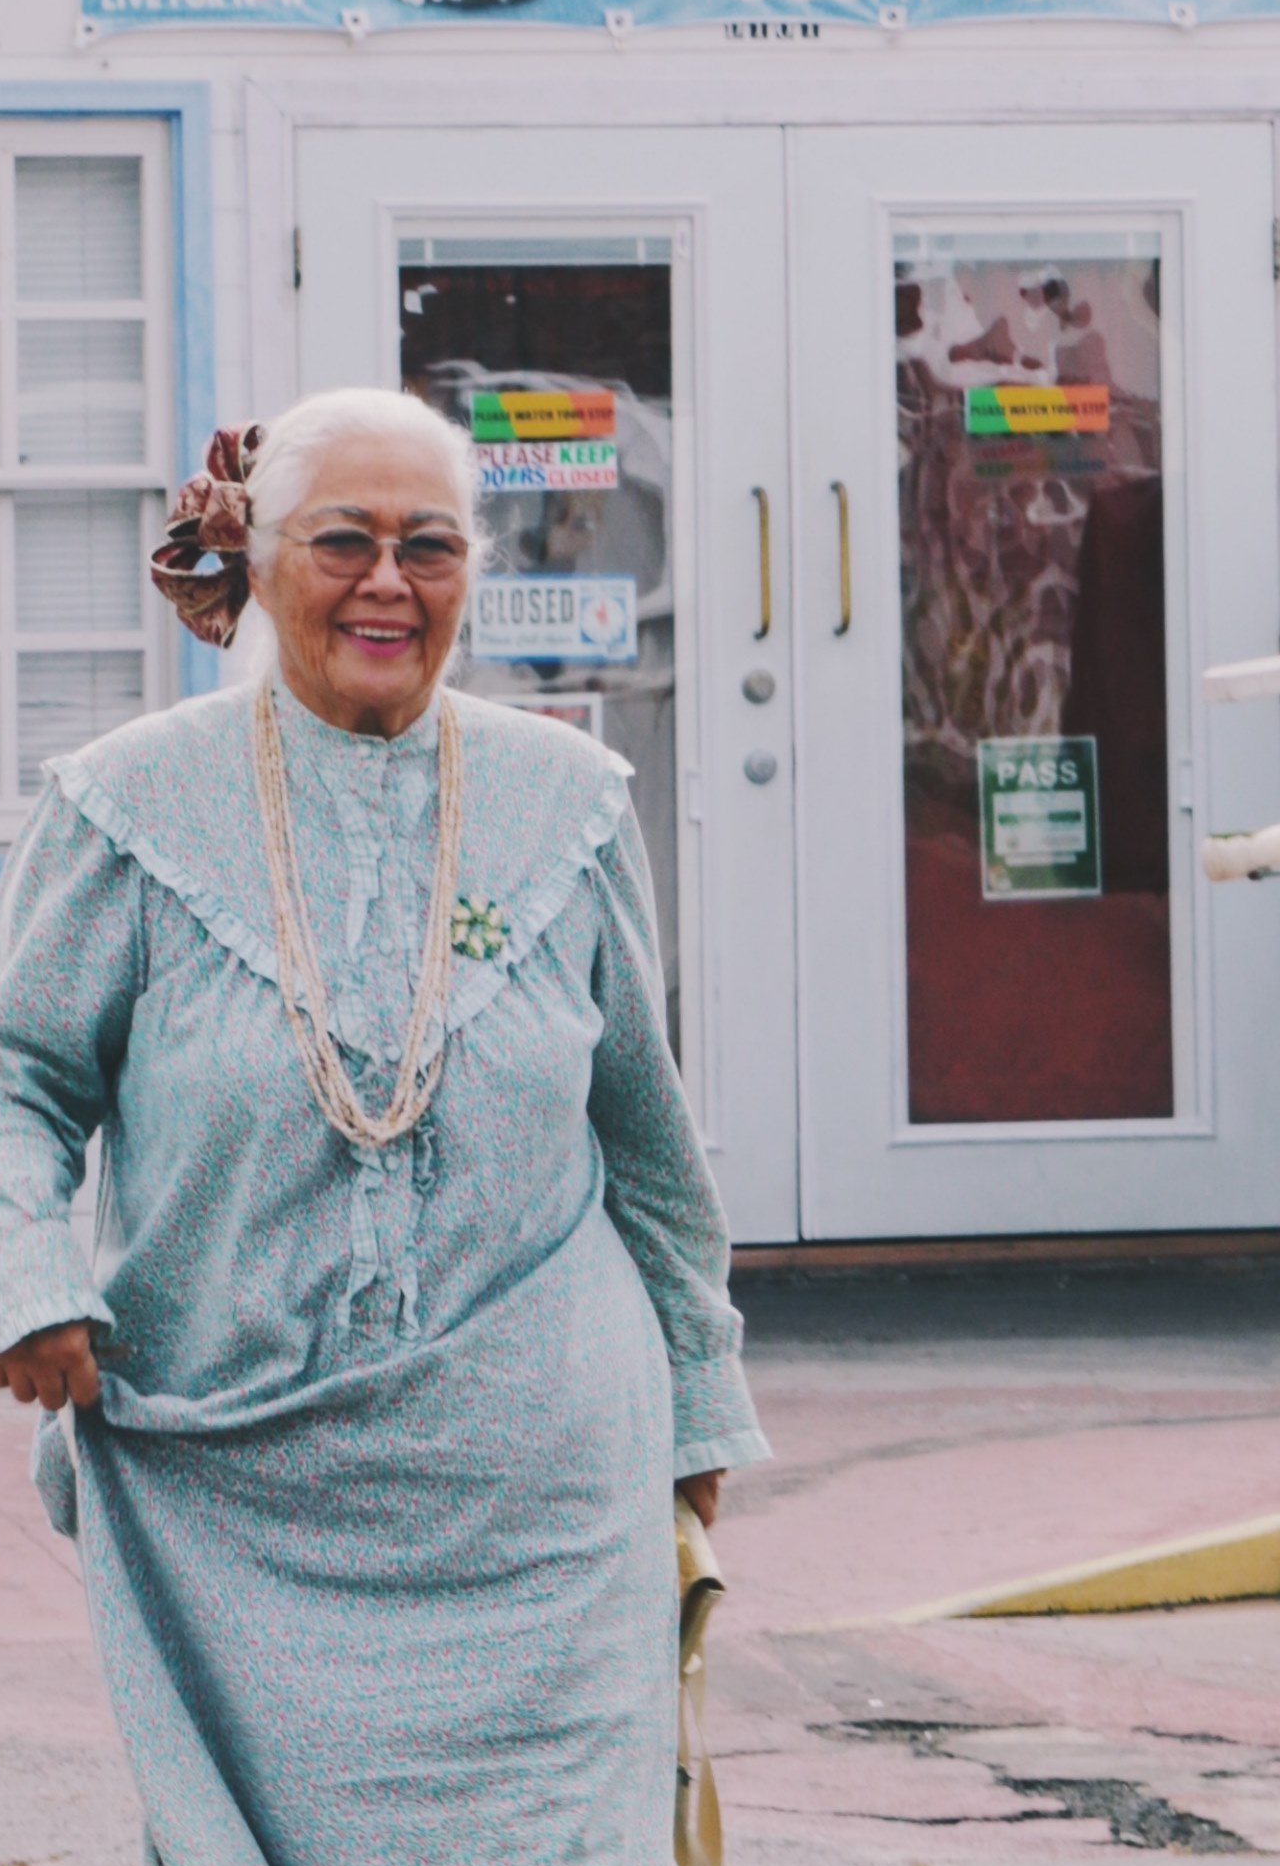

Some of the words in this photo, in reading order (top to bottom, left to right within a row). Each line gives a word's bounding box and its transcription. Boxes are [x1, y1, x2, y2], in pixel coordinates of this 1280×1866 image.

[477, 444, 555, 466] PLEASE
[559, 443, 615, 464] KEEP
[548, 467, 615, 485] CLOSED
[478, 588, 574, 625] CLOSED
[996, 759, 1079, 787] PASS
